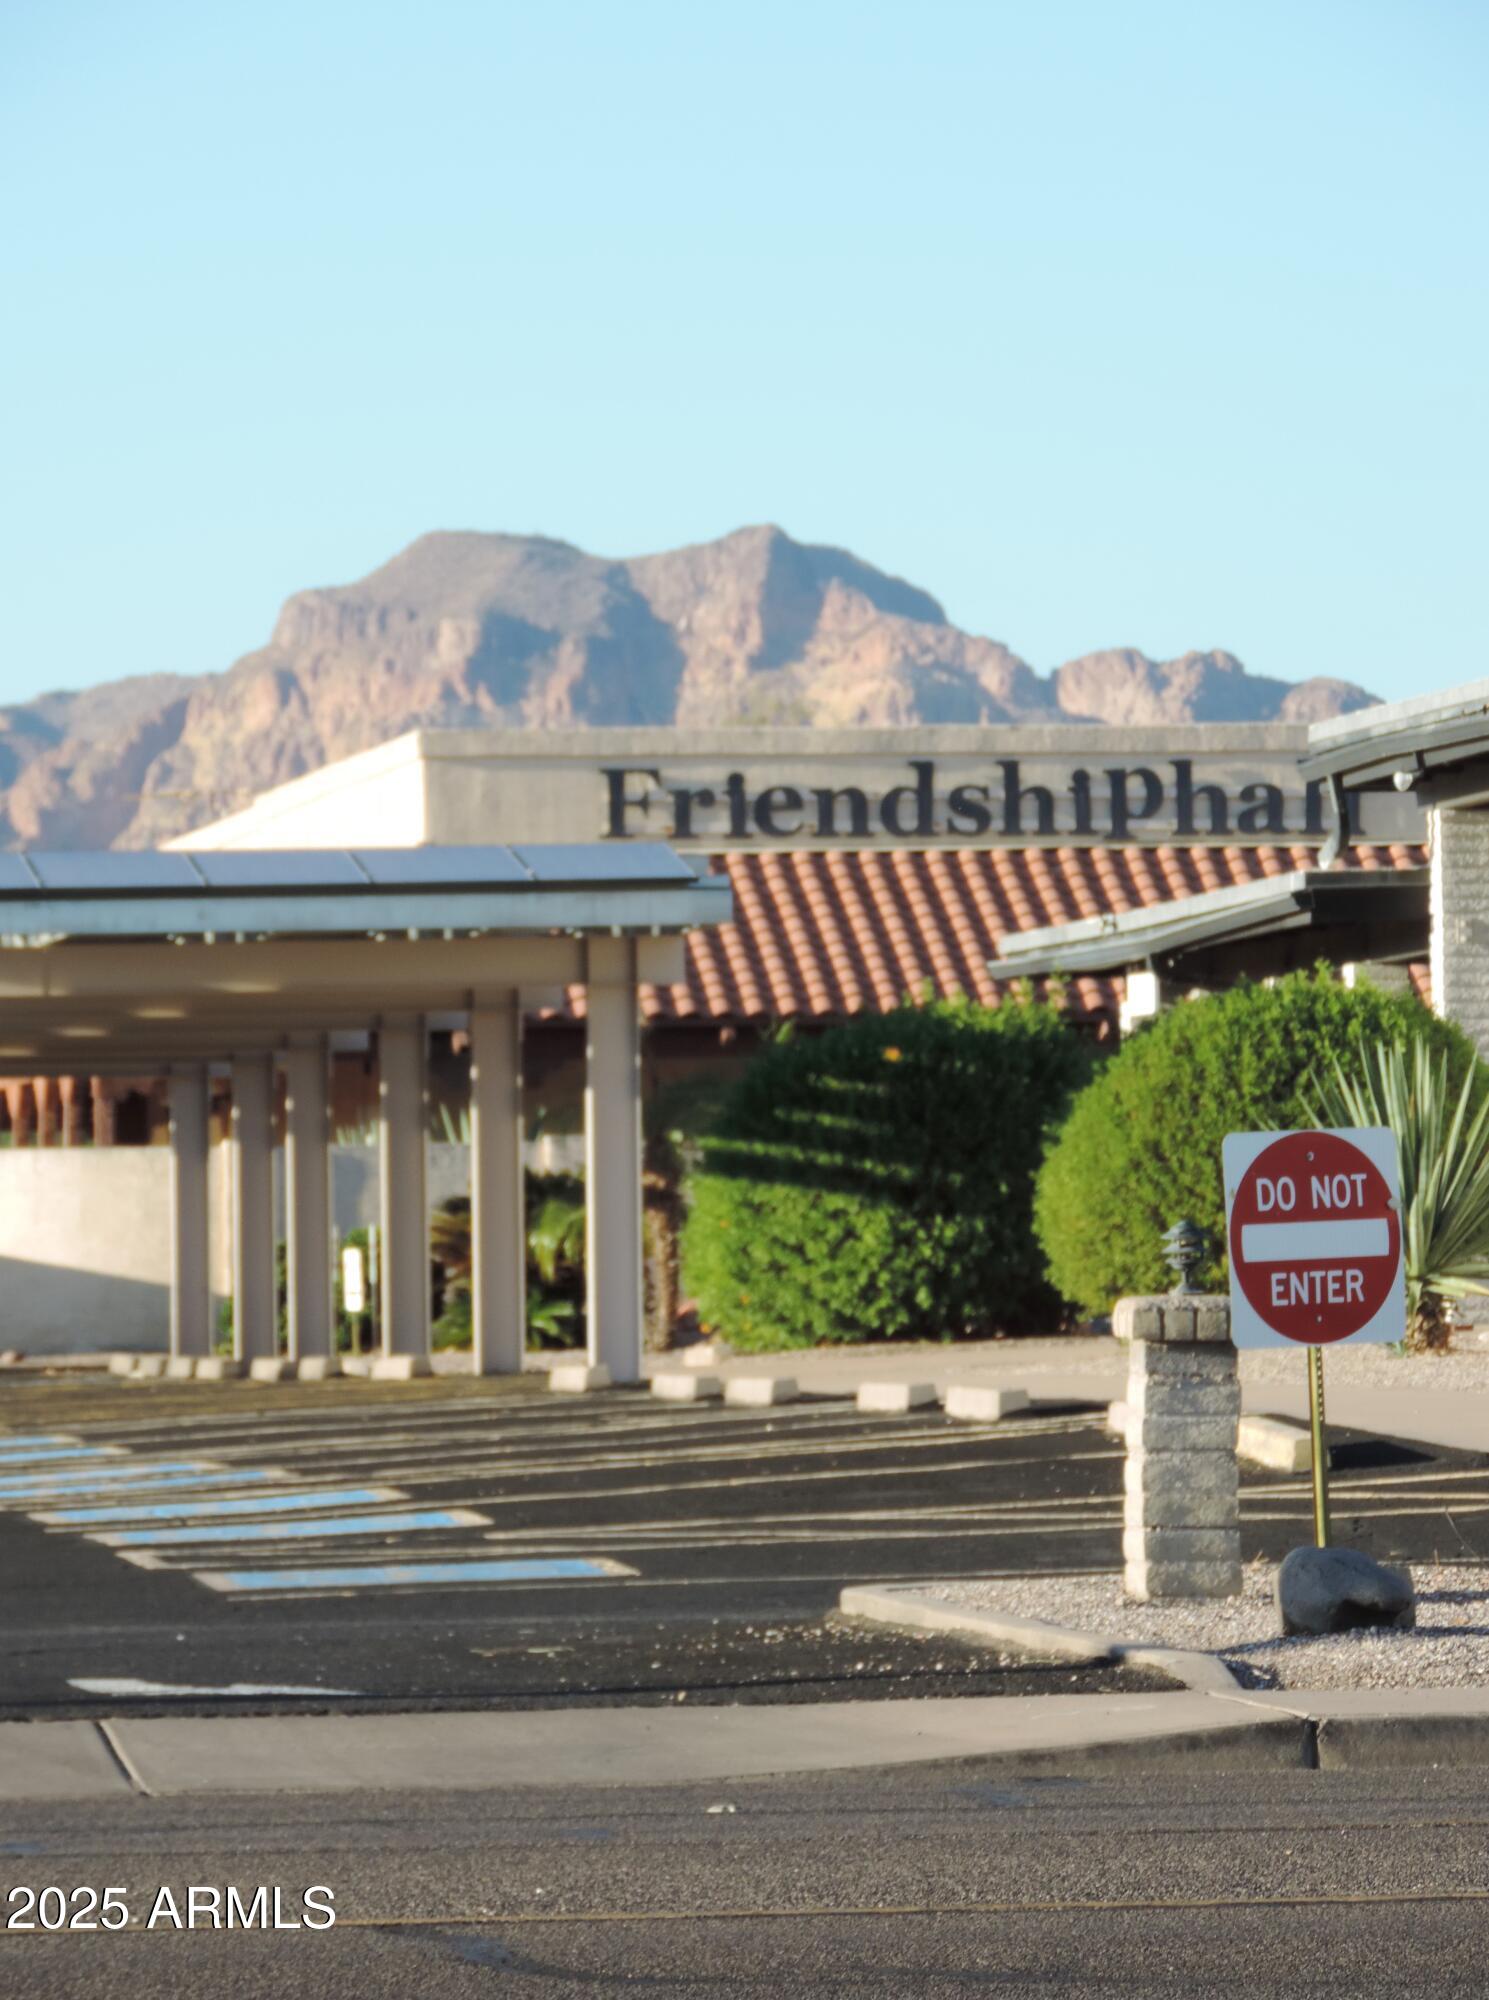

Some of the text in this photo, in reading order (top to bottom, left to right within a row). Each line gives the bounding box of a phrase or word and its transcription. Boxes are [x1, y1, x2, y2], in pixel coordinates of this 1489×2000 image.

[1255, 1173, 1367, 1212] DO NOT
[1270, 1268, 1364, 1307] ENTER
